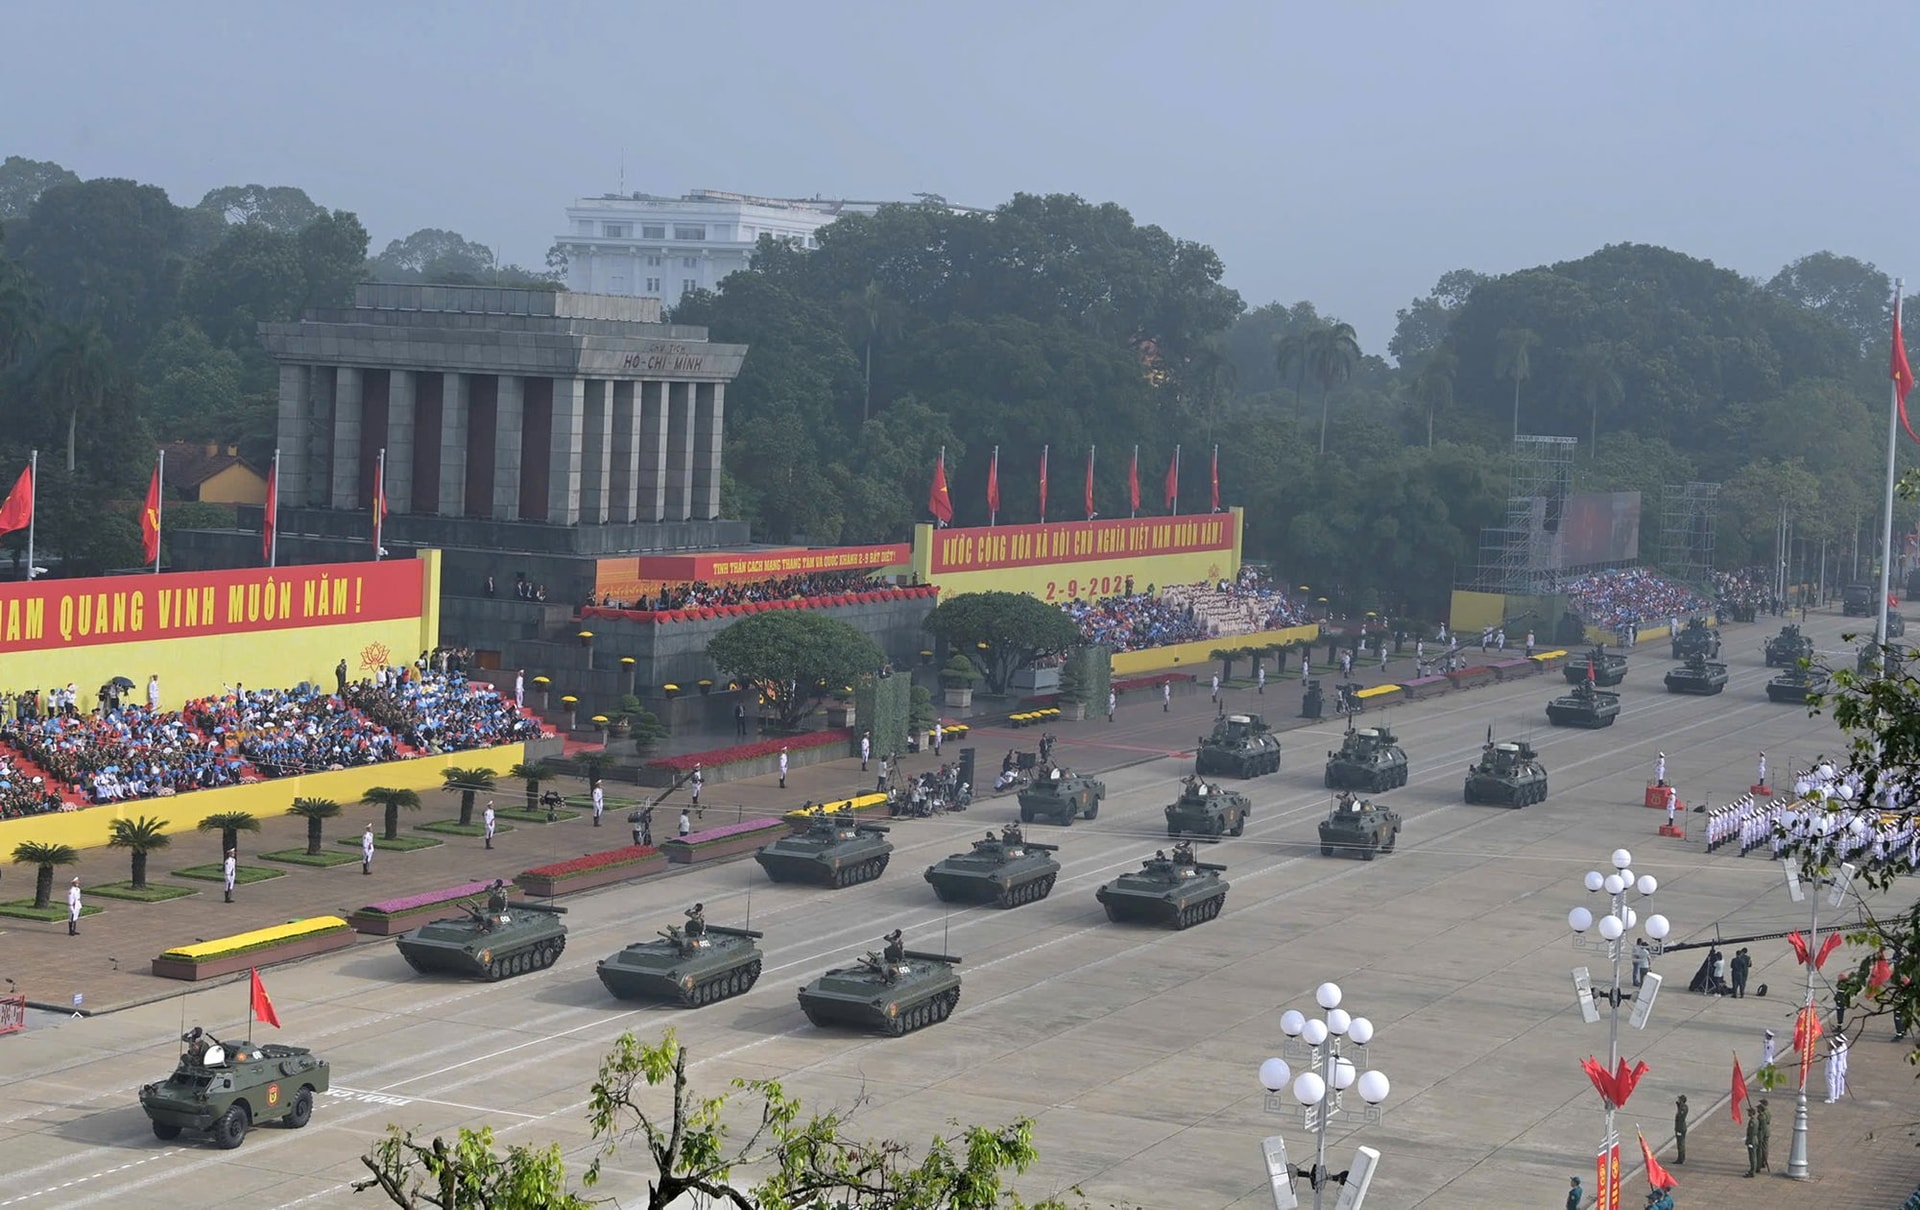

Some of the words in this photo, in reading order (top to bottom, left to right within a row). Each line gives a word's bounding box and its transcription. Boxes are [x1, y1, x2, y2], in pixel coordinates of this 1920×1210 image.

[943, 533, 973, 566] NƯỚC
[977, 532, 1007, 568] CỘNG
[1011, 529, 1031, 560] HÒA
[1035, 528, 1048, 559] XÃ
[1052, 527, 1070, 561] HỘI
[1074, 523, 1094, 555] CHỦ
[1097, 524, 1126, 553] NGHĨA
[1129, 522, 1149, 554] VIỆT
[1152, 524, 1171, 549] NAM
[1174, 519, 1199, 548] MUÔN
[0, 597, 44, 641] AM
[60, 590, 145, 641] QUANG
[158, 586, 215, 629] VINH
[227, 575, 292, 623] MUÔN
